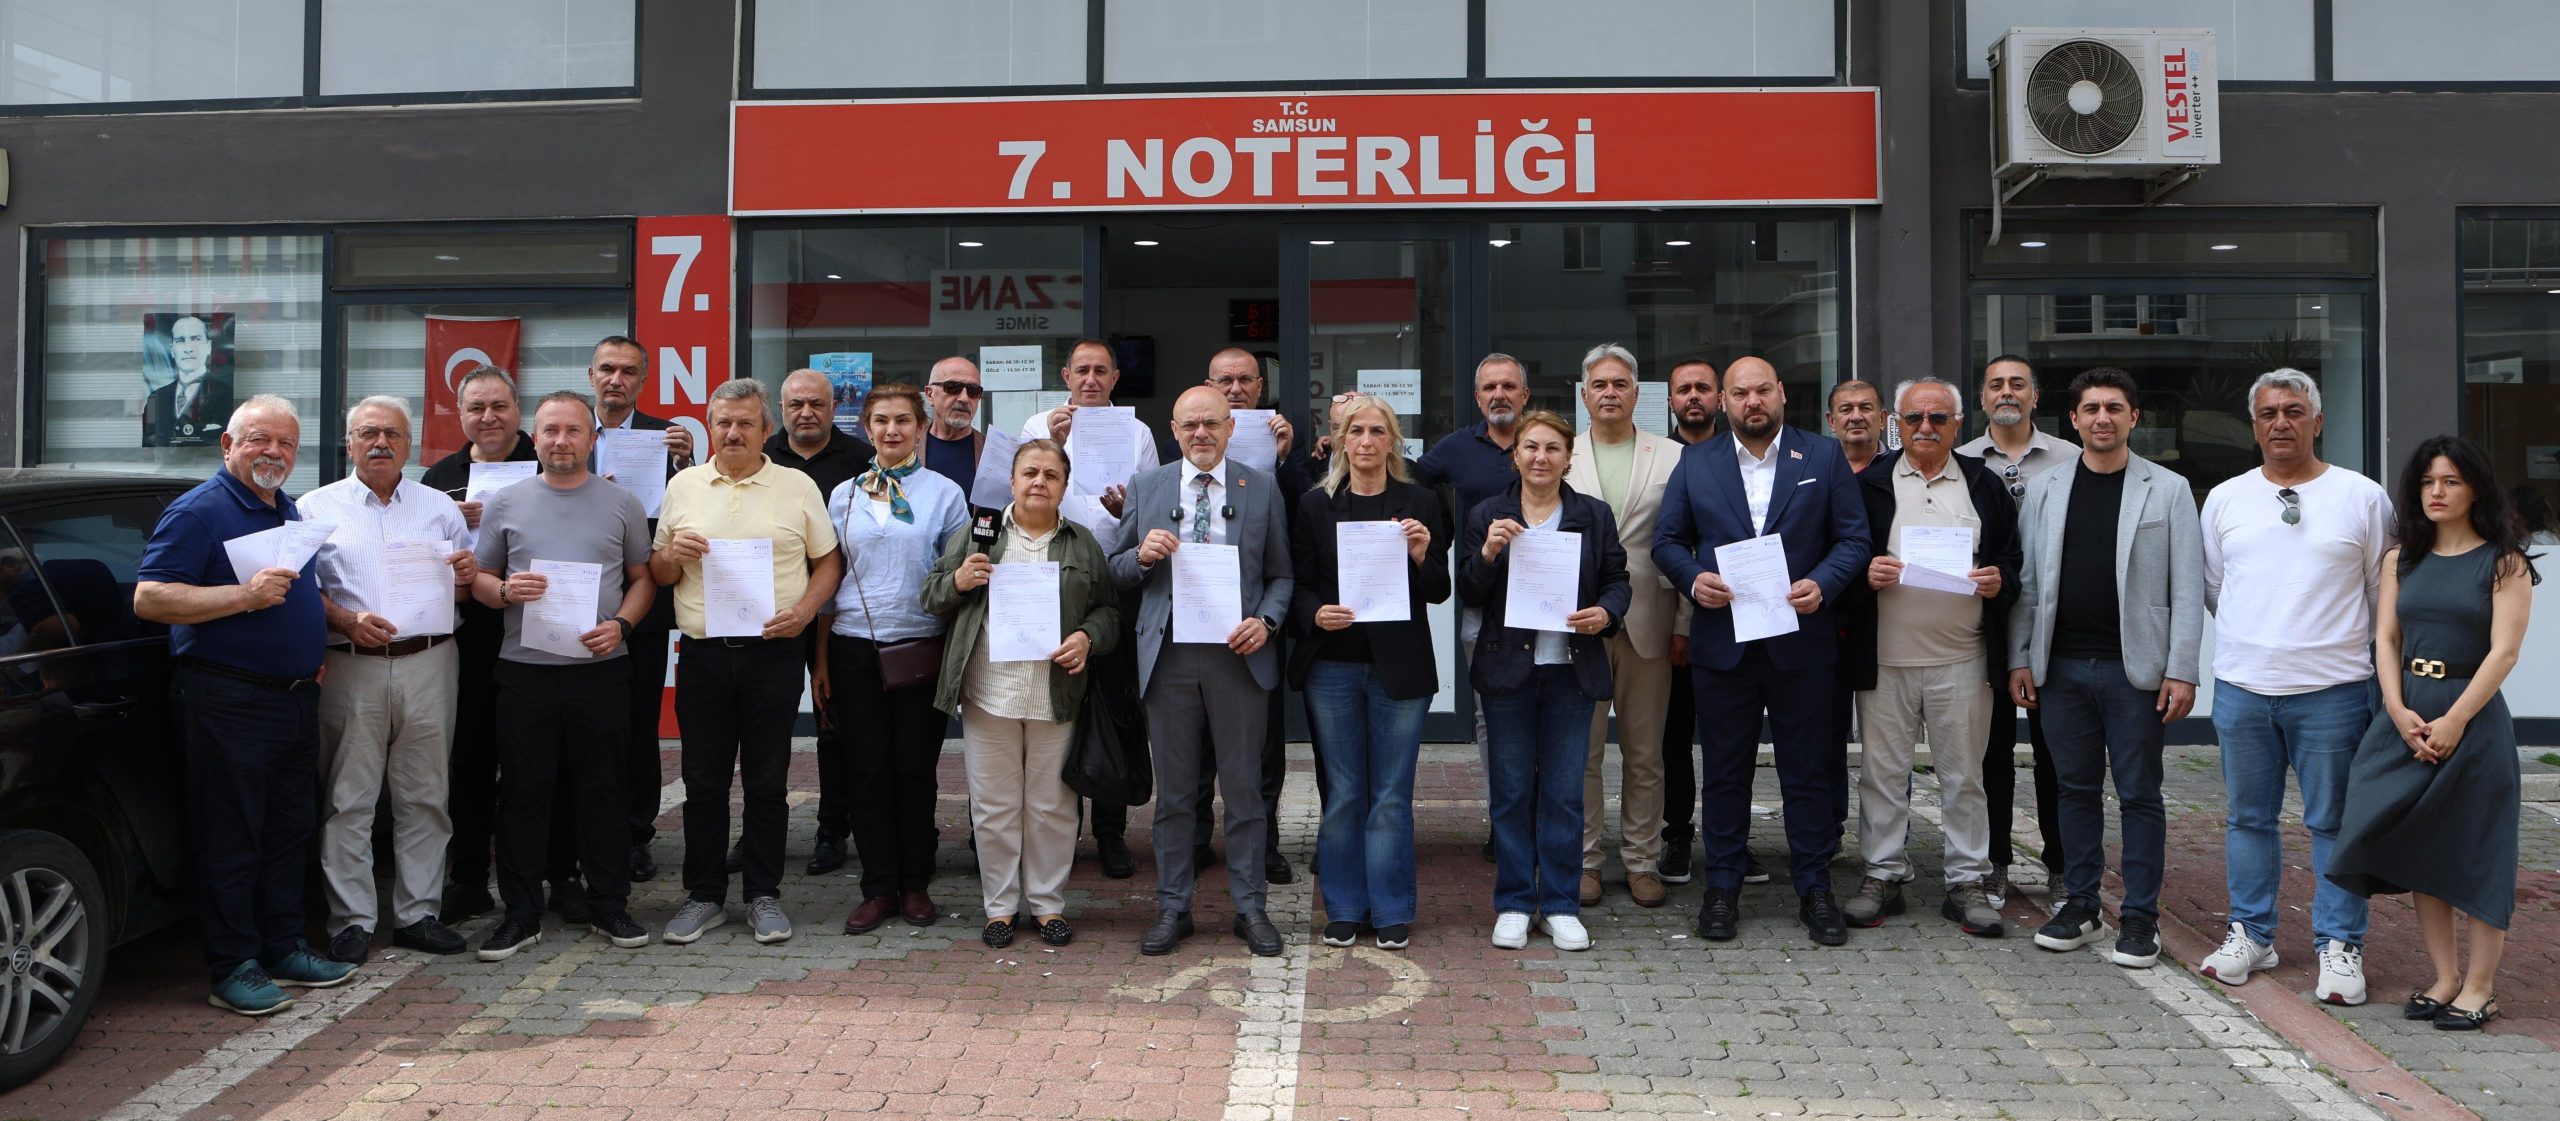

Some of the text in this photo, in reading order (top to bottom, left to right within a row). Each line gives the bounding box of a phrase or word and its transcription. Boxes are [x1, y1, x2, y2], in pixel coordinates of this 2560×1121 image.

[1252, 118, 1336, 133] SAMSUN
[1279, 101, 1309, 116] T.C
[2164, 47, 2189, 143] VESTEL
[998, 118, 1596, 200] 7. NOTERLİĞİ
[651, 235, 709, 312] 7.
